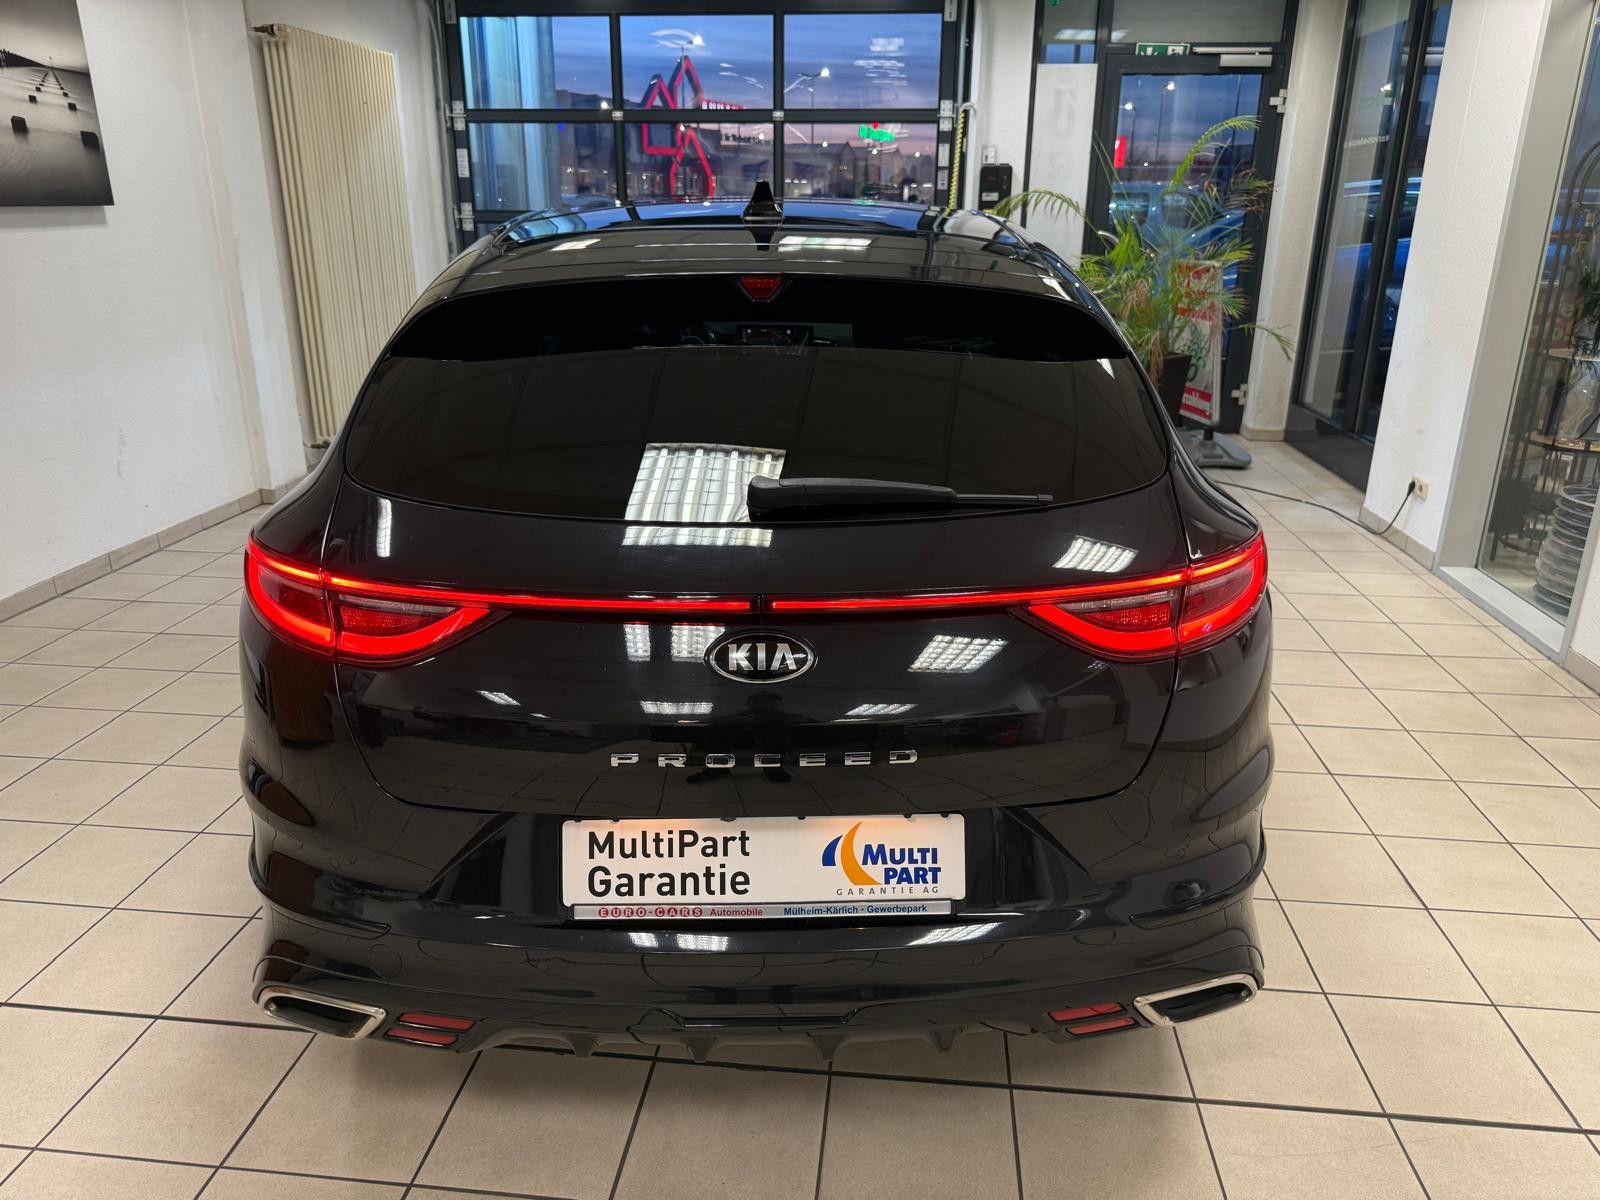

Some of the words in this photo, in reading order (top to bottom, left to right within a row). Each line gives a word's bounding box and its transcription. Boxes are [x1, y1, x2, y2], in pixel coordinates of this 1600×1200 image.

[728, 643, 797, 671] KIA
[610, 749, 918, 768] PROCEED
[588, 830, 750, 859] MultiPart
[861, 843, 938, 866] MULTI
[587, 864, 750, 897] Garantie
[883, 866, 942, 885] PART
[836, 886, 914, 896] GARANTIE
[923, 886, 939, 894] AG
[598, 906, 703, 918] EURO-CARS
[709, 907, 764, 917] Automobile
[783, 905, 859, 916] Mülheim-Kärlich
[866, 904, 928, 915] Gewerbepark
